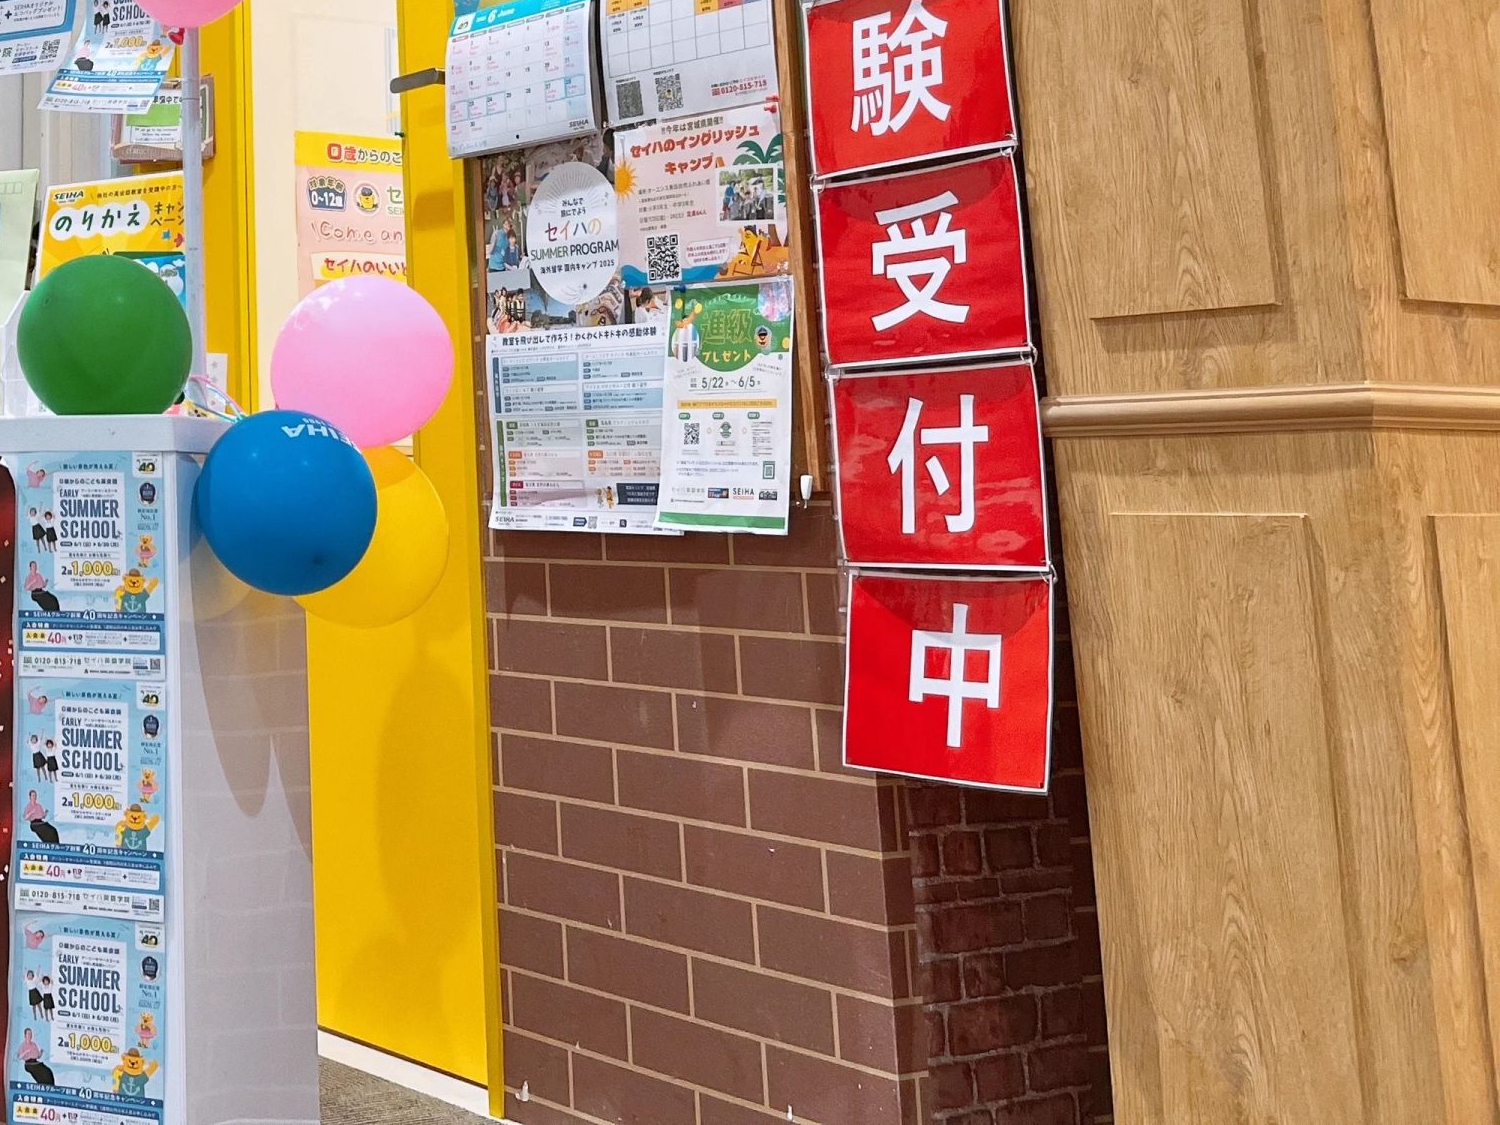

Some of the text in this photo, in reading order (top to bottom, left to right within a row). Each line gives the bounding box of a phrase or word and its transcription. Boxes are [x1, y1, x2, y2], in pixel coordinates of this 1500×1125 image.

[630, 125, 760, 158] セイハのイングリッシュ
[665, 152, 714, 174] キャンプ
[54, 191, 84, 200] SEIHA
[562, 198, 583, 206] みんなで
[55, 203, 140, 232] のりかえ
[321, 221, 372, 242] Come
[545, 218, 601, 242] セイハの
[531, 239, 619, 261] SUMMER PROGRAM
[600, 259, 615, 267] 2025
[702, 349, 752, 363] プレゼント
[701, 376, 755, 389] 5/22 6/5
[59, 489, 79, 498] EARLY
[60, 499, 119, 519] SUMMER
[60, 520, 119, 539] SCHOOL
[34, 657, 82, 666] 0120-815-718
[61, 717, 82, 726] EARLY
[62, 728, 122, 749] SUMMER
[62, 749, 121, 771] SCHOOL
[31, 890, 80, 901] 0120-815-718
[59, 953, 79, 964] EARLY
[58, 965, 120, 991] SUMMER
[58, 987, 120, 1013] SCHOOL
